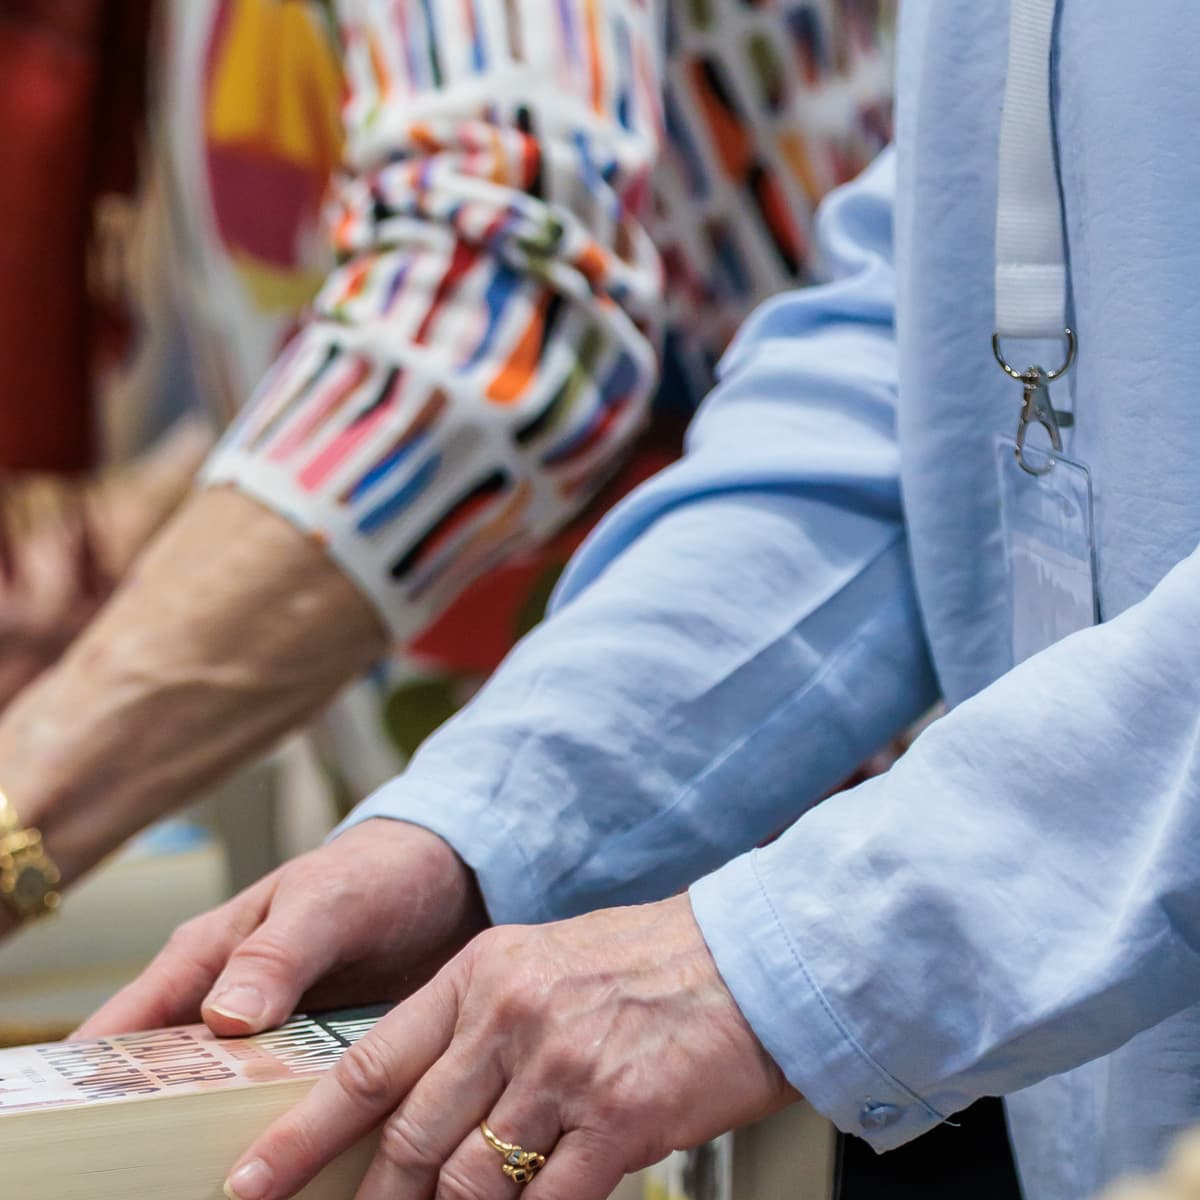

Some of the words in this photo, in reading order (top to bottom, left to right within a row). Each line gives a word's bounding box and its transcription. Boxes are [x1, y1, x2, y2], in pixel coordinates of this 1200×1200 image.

[115, 1030, 212, 1063] STADT
[36, 1040, 161, 1100] ERGELTUNG
[149, 1059, 238, 1087] DER
